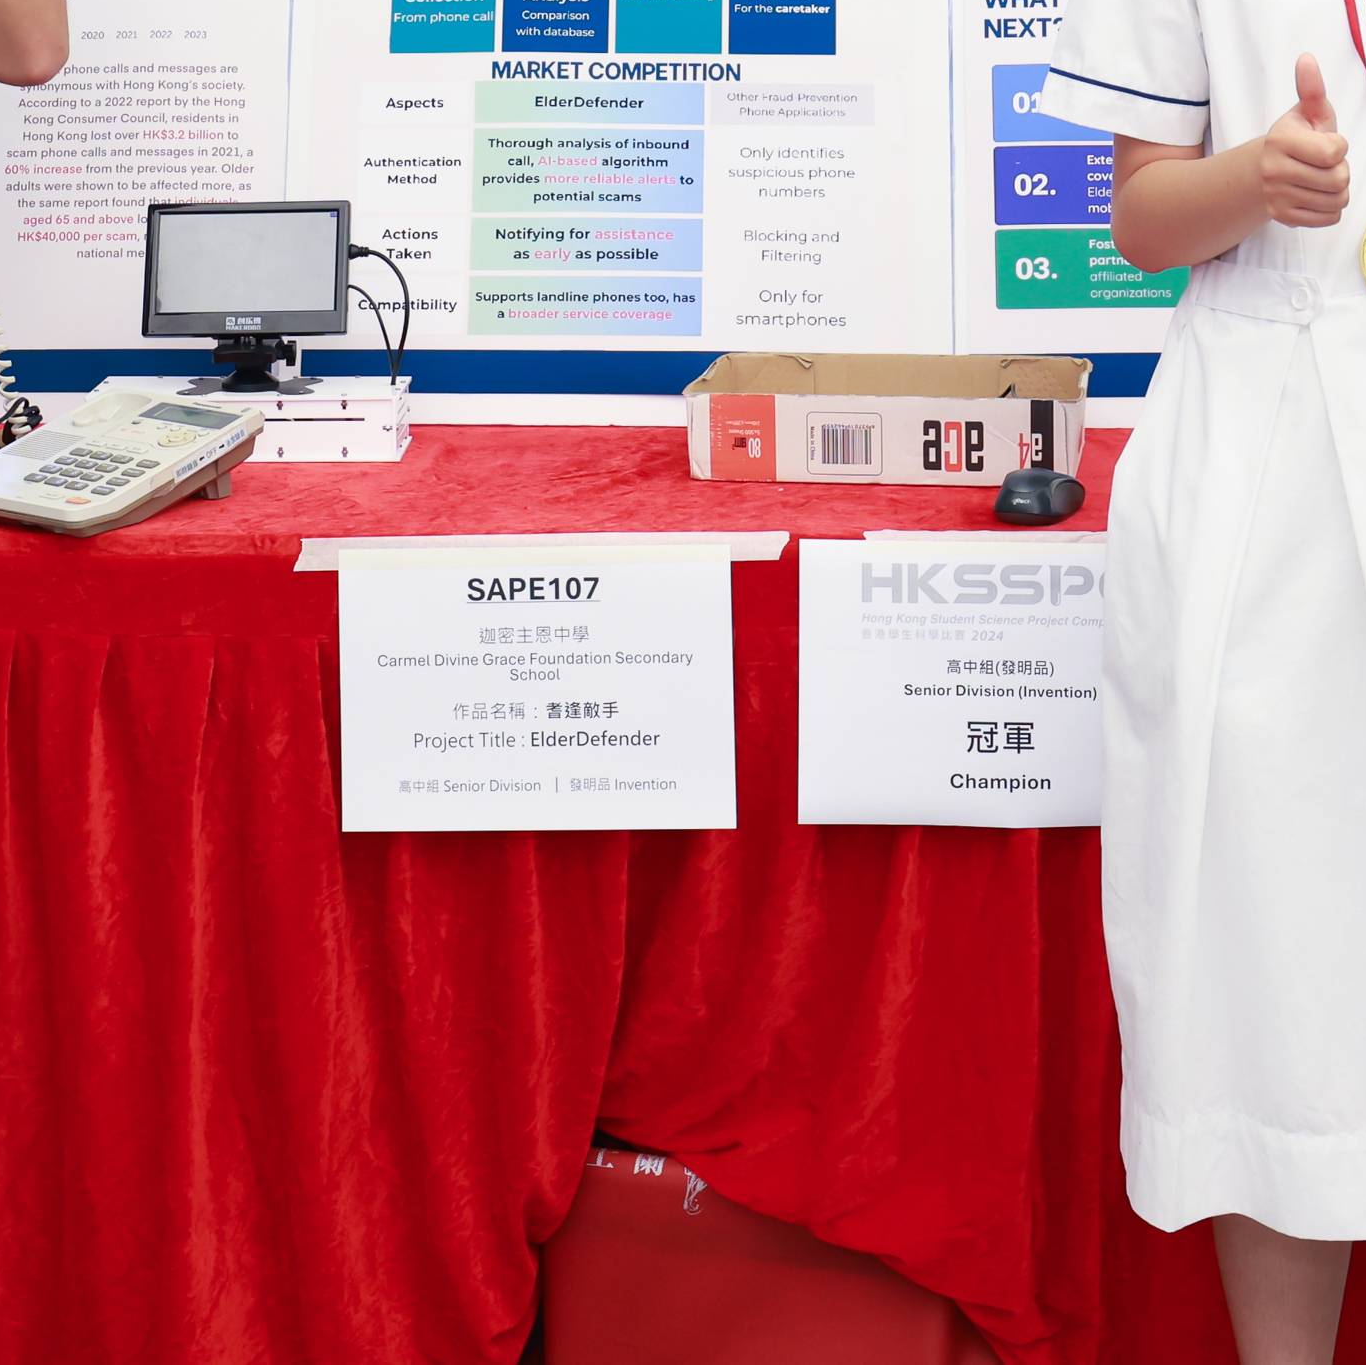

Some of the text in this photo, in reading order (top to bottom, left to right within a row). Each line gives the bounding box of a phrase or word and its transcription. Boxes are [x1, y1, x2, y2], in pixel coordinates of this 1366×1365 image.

[522, 10, 589, 21] Comparison
[735, 4, 830, 13] For the caretaker
[392, 11, 495, 24] From phone call
[81, 30, 207, 39] 2020 2021 2022 2023
[516, 27, 594, 36] with database
[492, 61, 740, 81] MARKET COMPETITION
[18, 98, 76, 109] According
[81, 99, 91, 107] to
[105, 97, 132, 106] 2022
[137, 98, 170, 108] report
[175, 96, 188, 108] by
[193, 97, 210, 106] the
[214, 97, 245, 109] Hong
[386, 98, 443, 111] Aspects
[535, 96, 644, 108] ElderDefender
[364, 157, 461, 167] Authentication
[388, 174, 436, 184] Method
[1013, 173, 1057, 196] 02.
[382, 228, 438, 239] Actions
[385, 248, 431, 263] Taken
[1016, 257, 1057, 280] 03.
[1090, 269, 1144, 281] affiliated
[1090, 289, 1171, 300] organizations
[467, 577, 600, 601] SAPE107
[861, 563, 1105, 606] HKSSP
[862, 614, 892, 625] Hong
[896, 614, 927, 625] Kong
[931, 614, 974, 625] Student
[979, 615, 1023, 626] Science
[1027, 615, 1068, 628] Project
[480, 626, 589, 644] 迦密主恩中學
[378, 651, 693, 667] Carmel Divine Grace Foundation Secondary
[510, 668, 560, 681] School
[947, 660, 1054, 677] 高中組(發明品)
[905, 684, 1096, 701] Senior Division (Invention)
[453, 702, 618, 720] 作品名稱 耆逢敵手
[414, 730, 660, 753] Project Title ElderDefender
[967, 722, 1035, 754] 冠軍
[399, 780, 439, 794] 高中組
[444, 780, 485, 792] Senior
[490, 780, 541, 791] Division
[615, 778, 676, 790] Invention
[951, 774, 1050, 793] Champion
